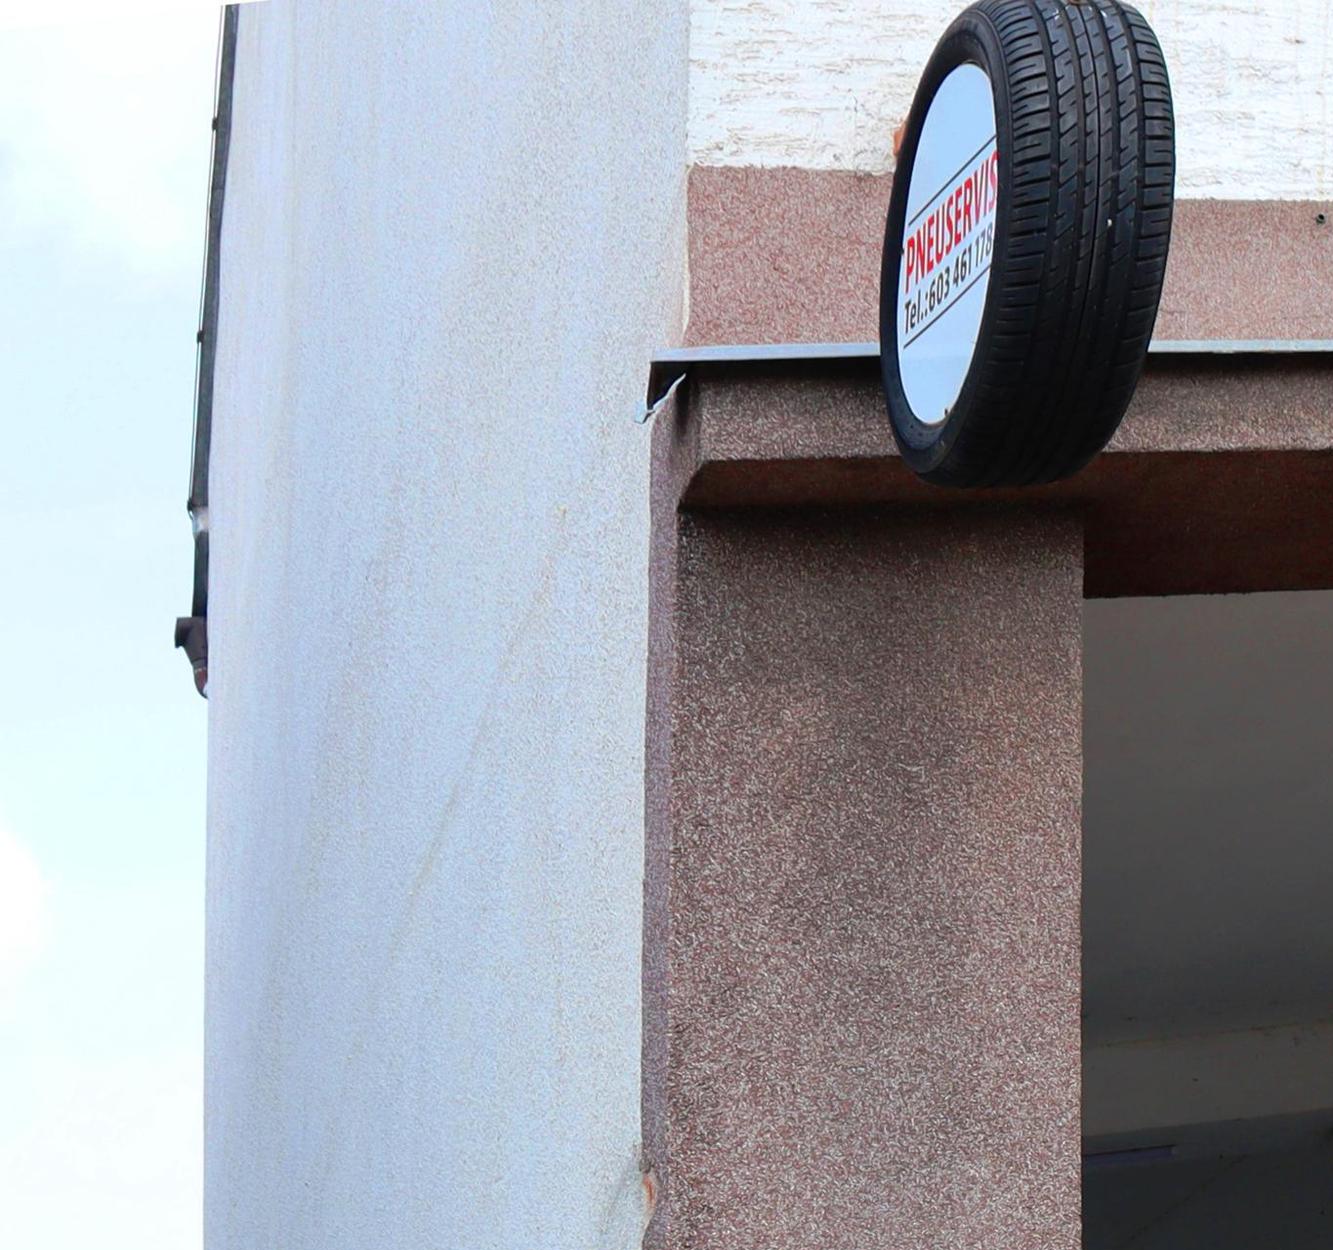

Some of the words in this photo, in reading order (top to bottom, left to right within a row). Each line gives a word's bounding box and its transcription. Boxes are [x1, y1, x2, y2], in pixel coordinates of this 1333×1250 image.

[904, 150, 999, 294] PNEUSERVIS
[952, 243, 973, 288] 461
[974, 222, 994, 268] 178
